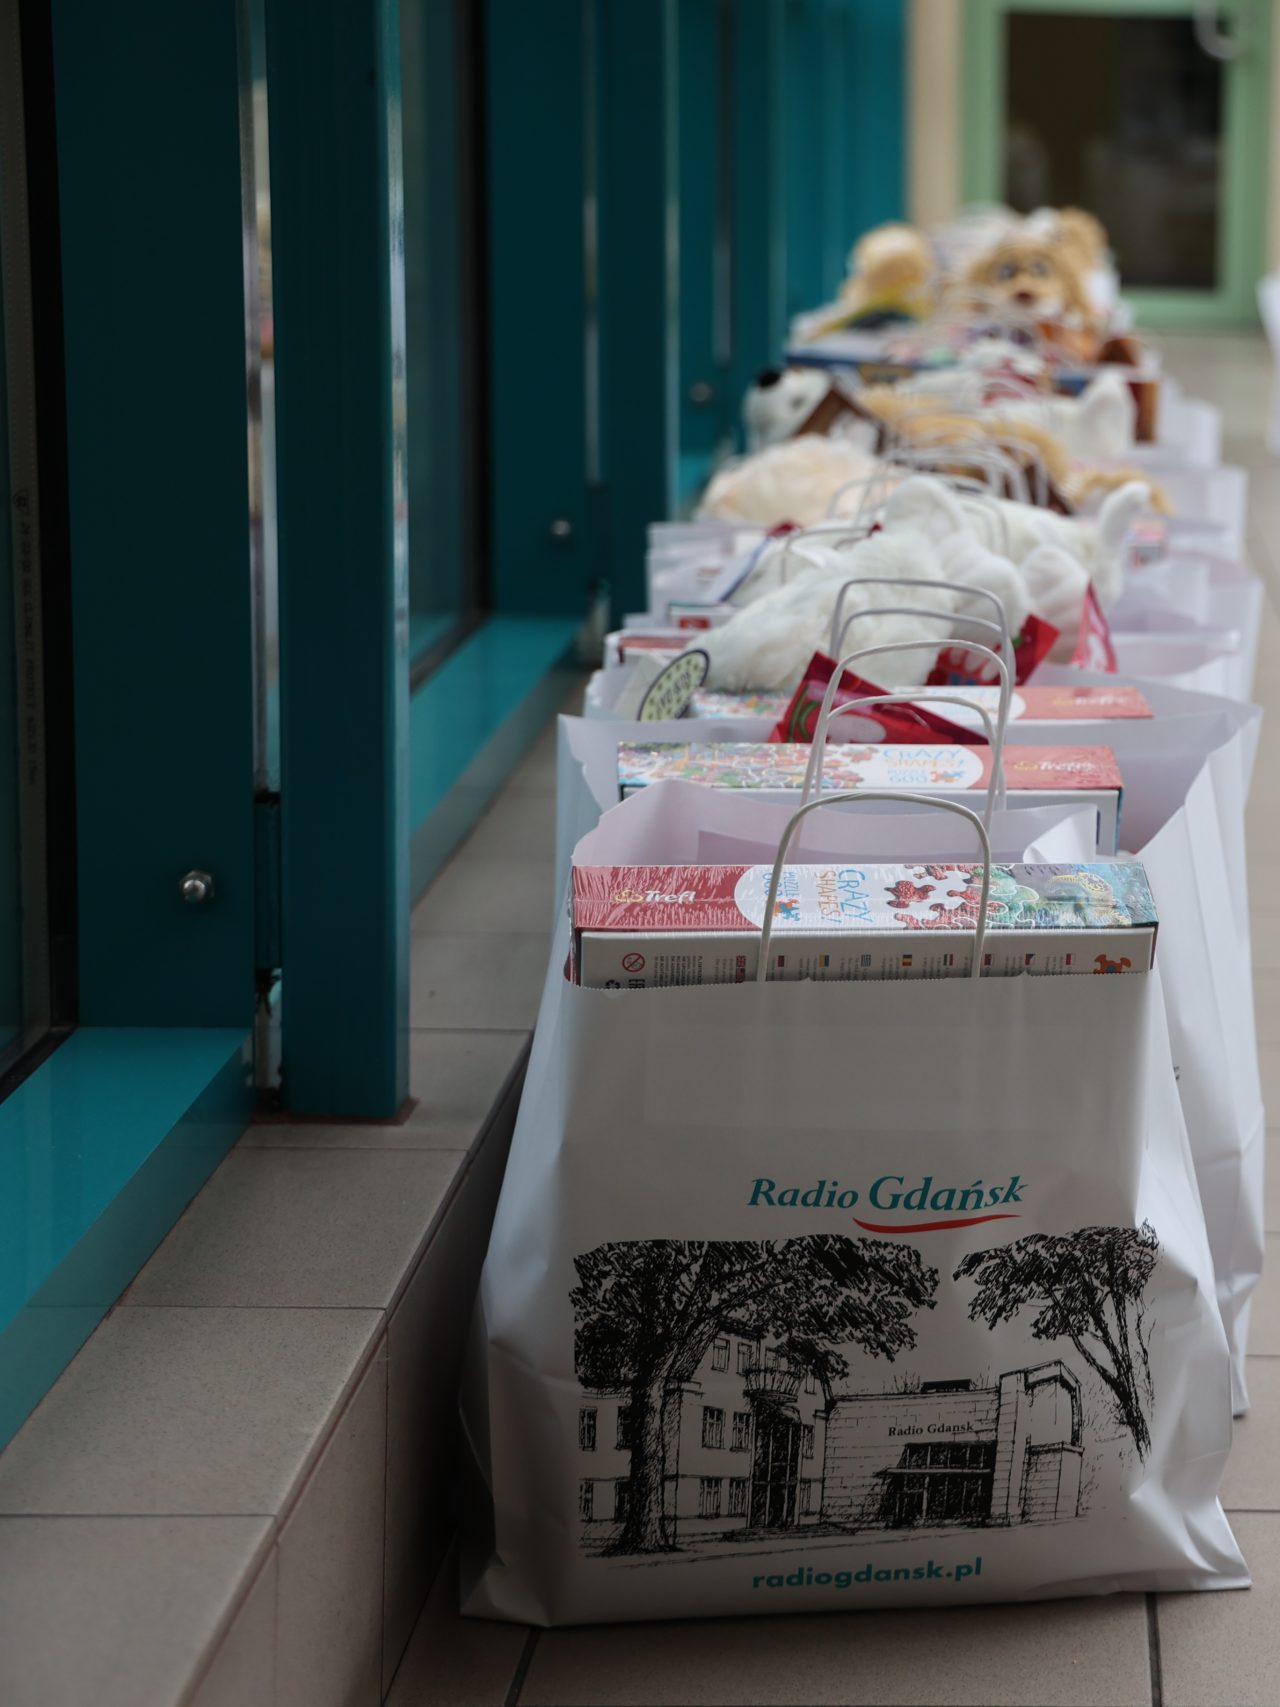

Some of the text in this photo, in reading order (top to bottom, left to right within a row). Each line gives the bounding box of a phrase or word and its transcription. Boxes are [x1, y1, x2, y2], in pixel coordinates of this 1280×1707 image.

[882, 748, 964, 760] CRAZY
[644, 890, 697, 905] Trefl
[814, 868, 843, 924] SHAPES!
[838, 869, 873, 923] CRAZY
[746, 1175, 1030, 1211] Radio Gdańsk
[888, 1421, 975, 1437] Radio Gdansk
[752, 1556, 983, 1589] radiogdansk.pl
